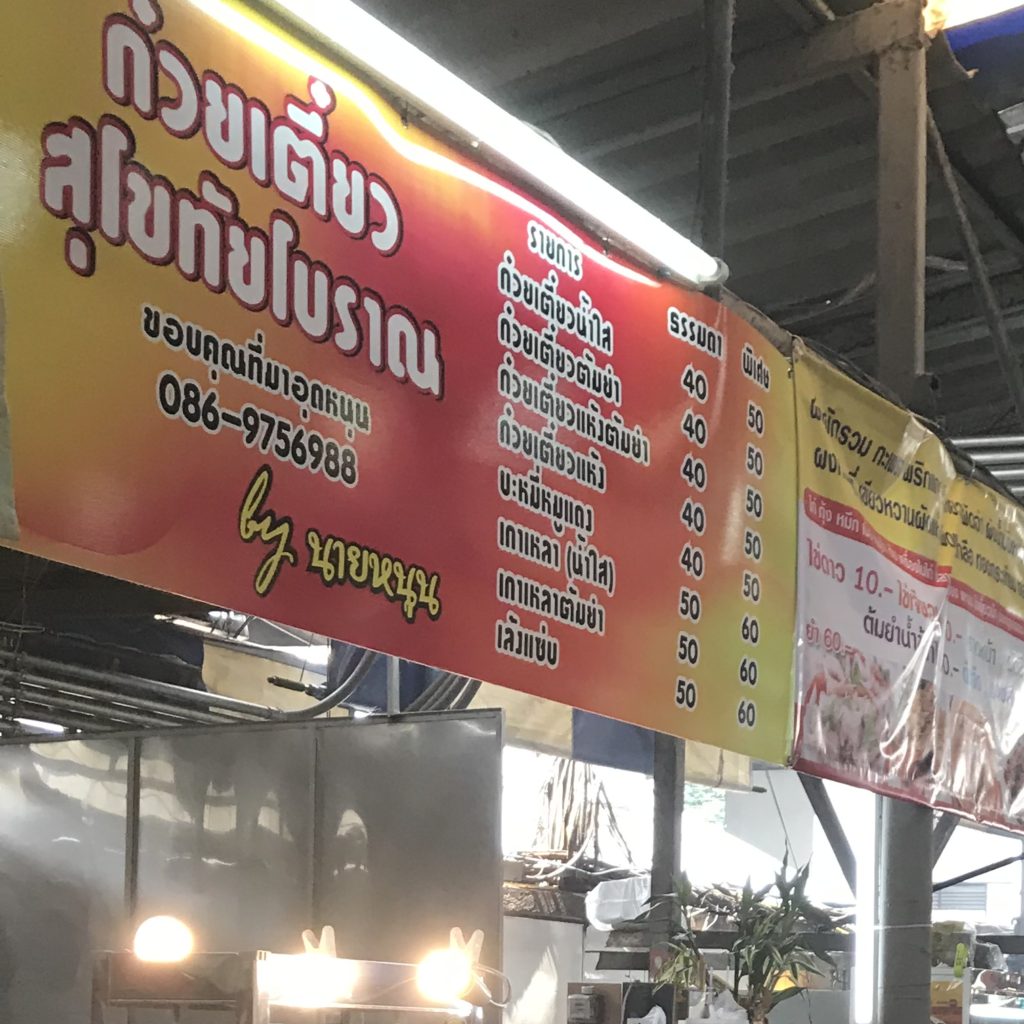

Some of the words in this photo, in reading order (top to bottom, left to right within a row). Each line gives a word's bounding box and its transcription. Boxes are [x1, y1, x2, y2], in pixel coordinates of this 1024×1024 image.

[43, 116, 442, 398] สุโขทัยโบราณ
[530, 225, 580, 276] รายการ
[670, 311, 722, 356] ธรรมดา
[743, 346, 769, 389] พิเศษ
[144, 307, 369, 438] ขอบคุณที่มาอุดหนุน
[683, 369, 706, 400] 40
[748, 405, 763, 434] 50
[159, 373, 356, 484] 086-9756988
[683, 414, 705, 444] 40
[747, 447, 763, 475] 50
[240, 468, 294, 596] by
[682, 502, 704, 532] 40
[745, 532, 761, 559] 50
[683, 458, 705, 488] 40
[746, 489, 761, 517] 50
[500, 521, 559, 567] เกาเหลา
[566, 533, 613, 593] (น้ำใส)
[680, 591, 699, 619] 50
[742, 617, 758, 643] 60
[681, 547, 703, 576] 40
[743, 574, 759, 601] 50
[807, 538, 845, 583] ไข่ดาว
[498, 615, 557, 665] เล้งแซ่บ
[676, 680, 695, 708] 50
[738, 701, 755, 726] 60
[499, 572, 603, 632] เกาเหลาต้มยำ
[679, 636, 698, 664] 50
[740, 659, 757, 685] 60
